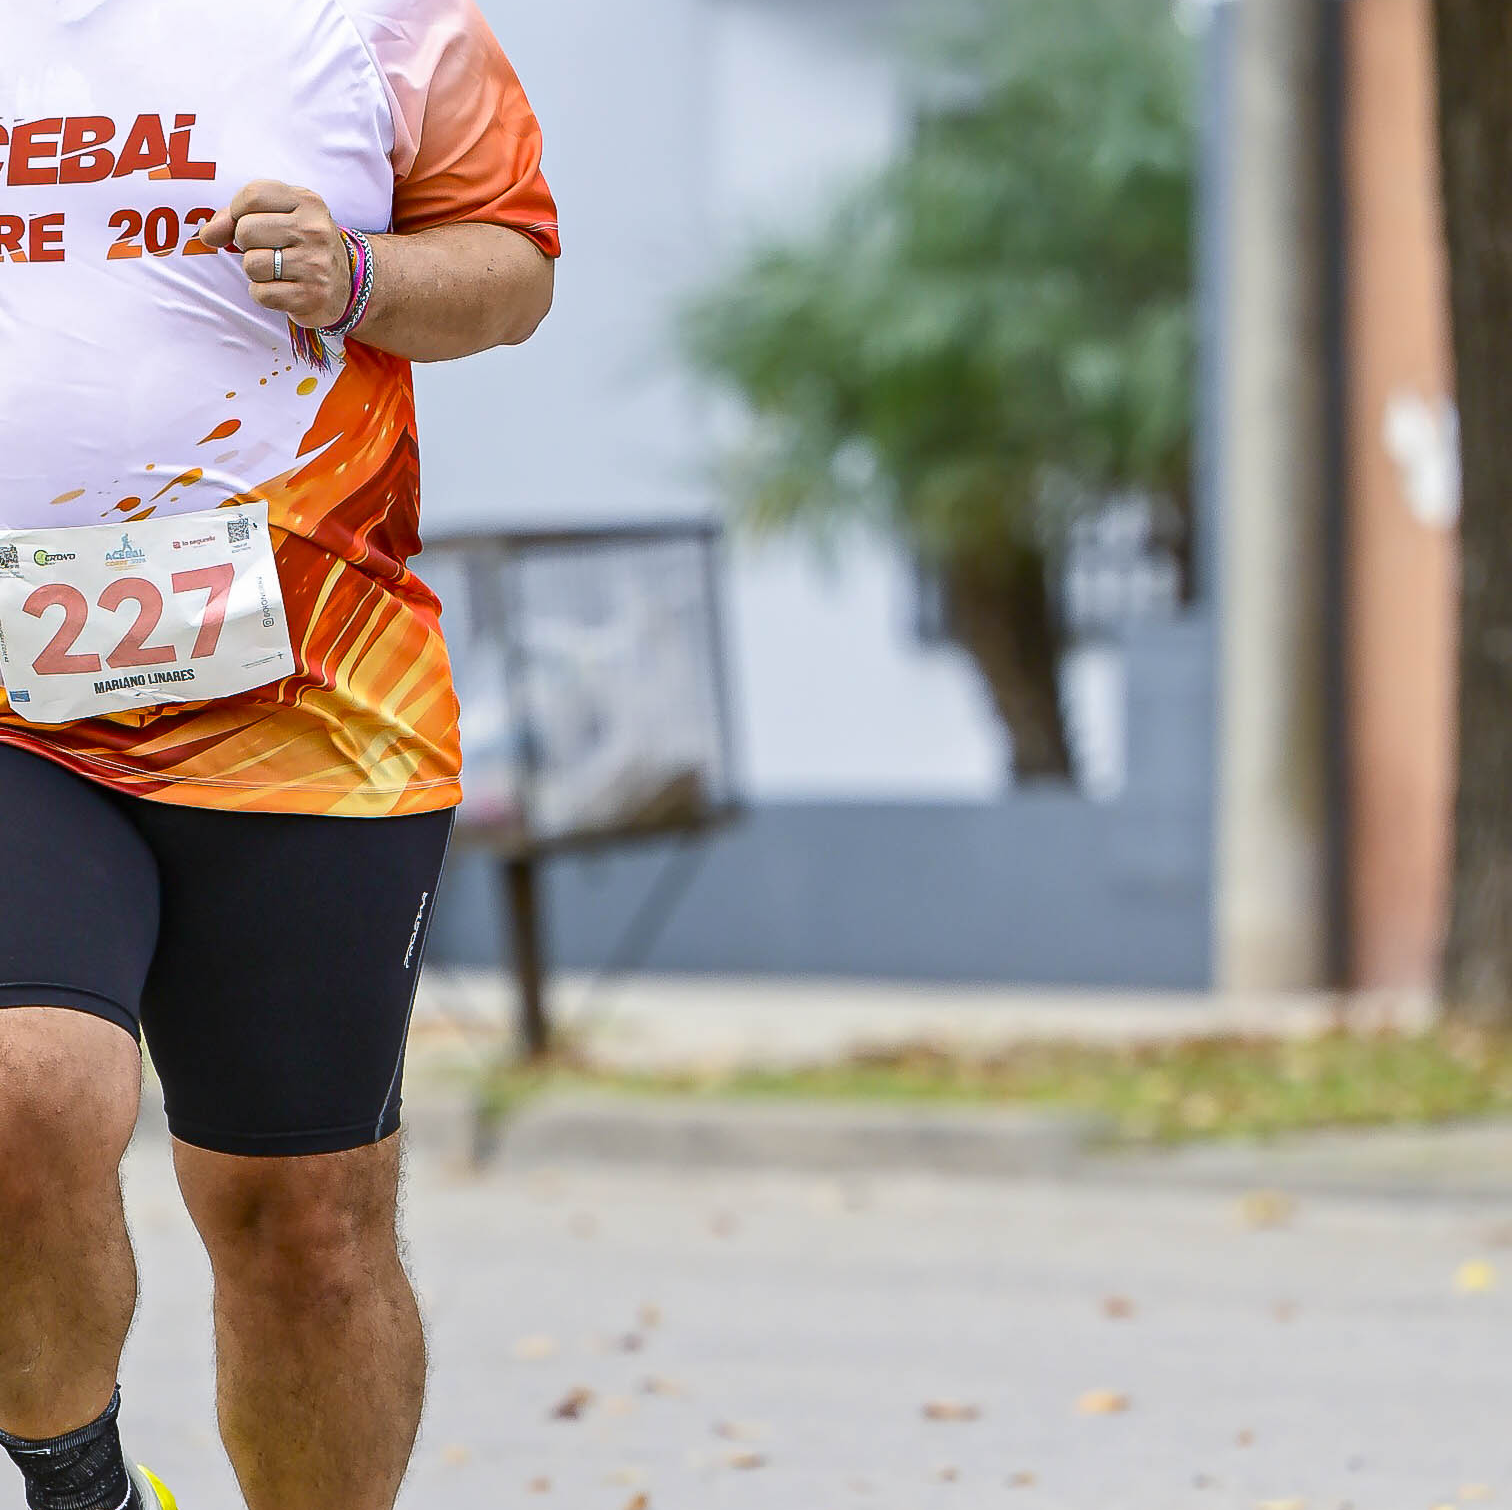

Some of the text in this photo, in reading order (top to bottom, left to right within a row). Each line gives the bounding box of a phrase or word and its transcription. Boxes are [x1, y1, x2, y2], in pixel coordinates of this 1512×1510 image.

[106, 206, 246, 261] 202
[22, 563, 235, 675] 227
[94, 668, 195, 694] MARIANO LINARES
